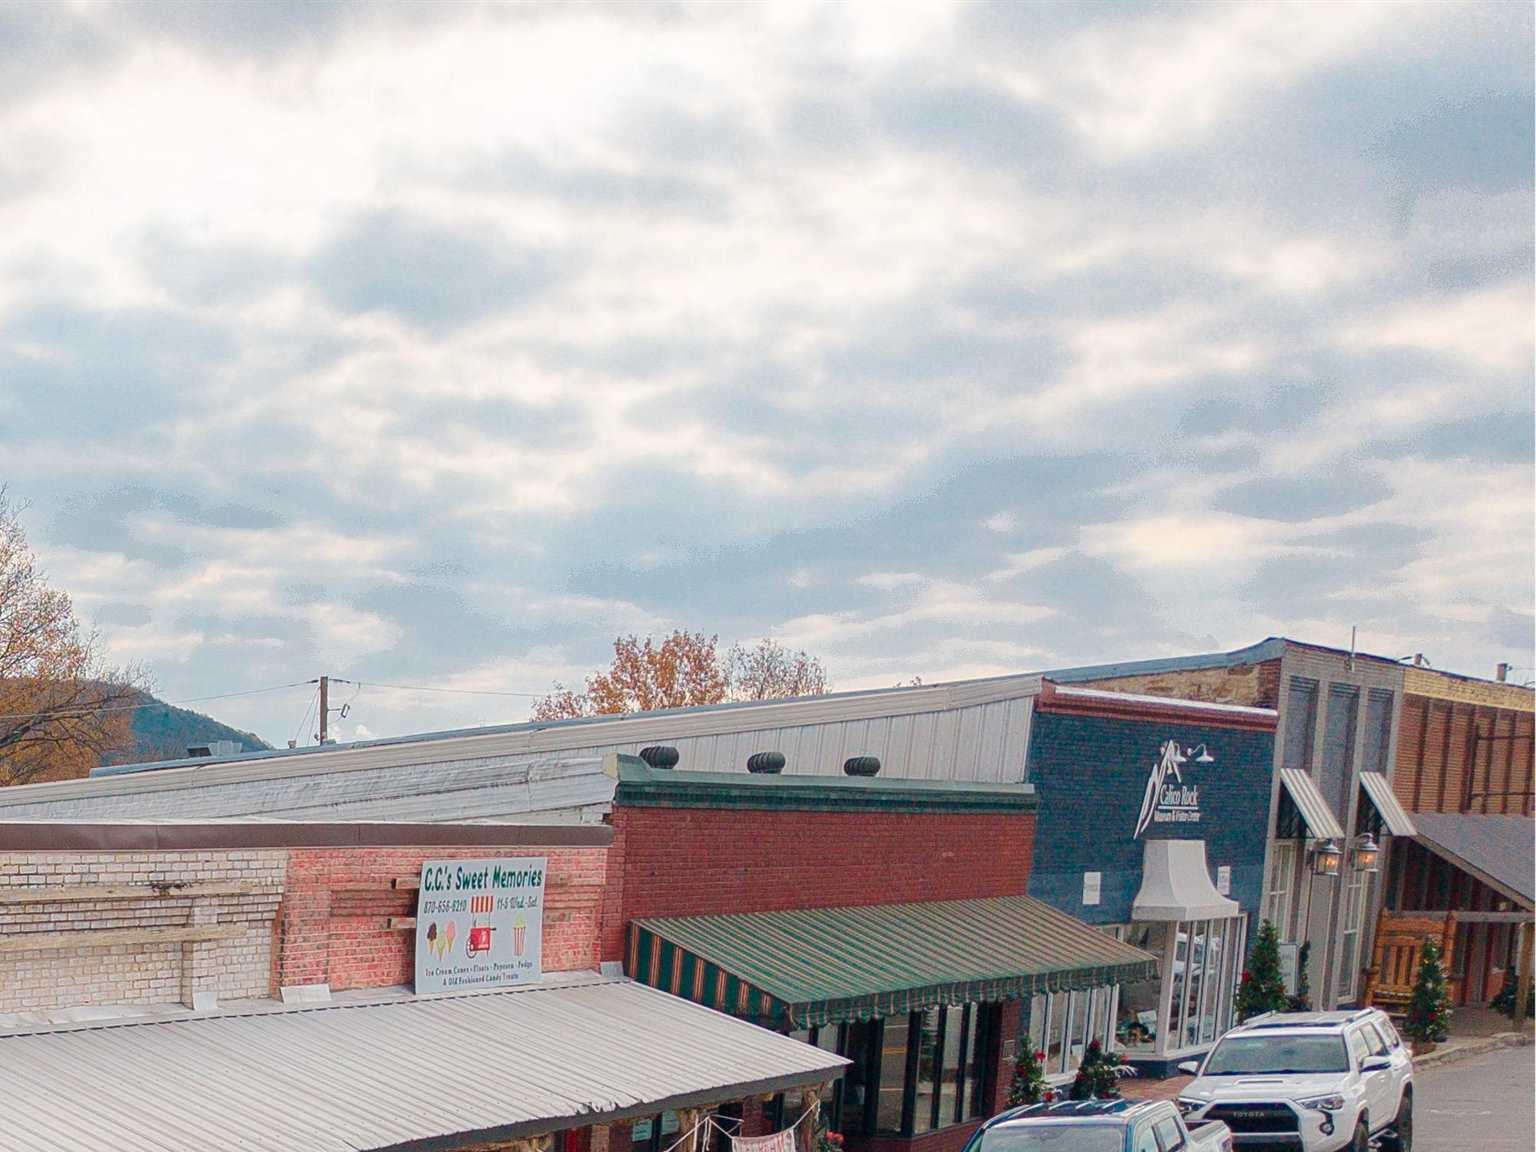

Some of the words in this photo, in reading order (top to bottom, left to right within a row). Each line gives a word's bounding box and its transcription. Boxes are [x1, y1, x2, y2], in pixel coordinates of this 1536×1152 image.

[1160, 784, 1180, 804] Calico
[1181, 785, 1198, 805] Rock
[425, 866, 451, 891] C.C.'s
[456, 866, 488, 890] Sweet
[492, 864, 543, 888] Memories
